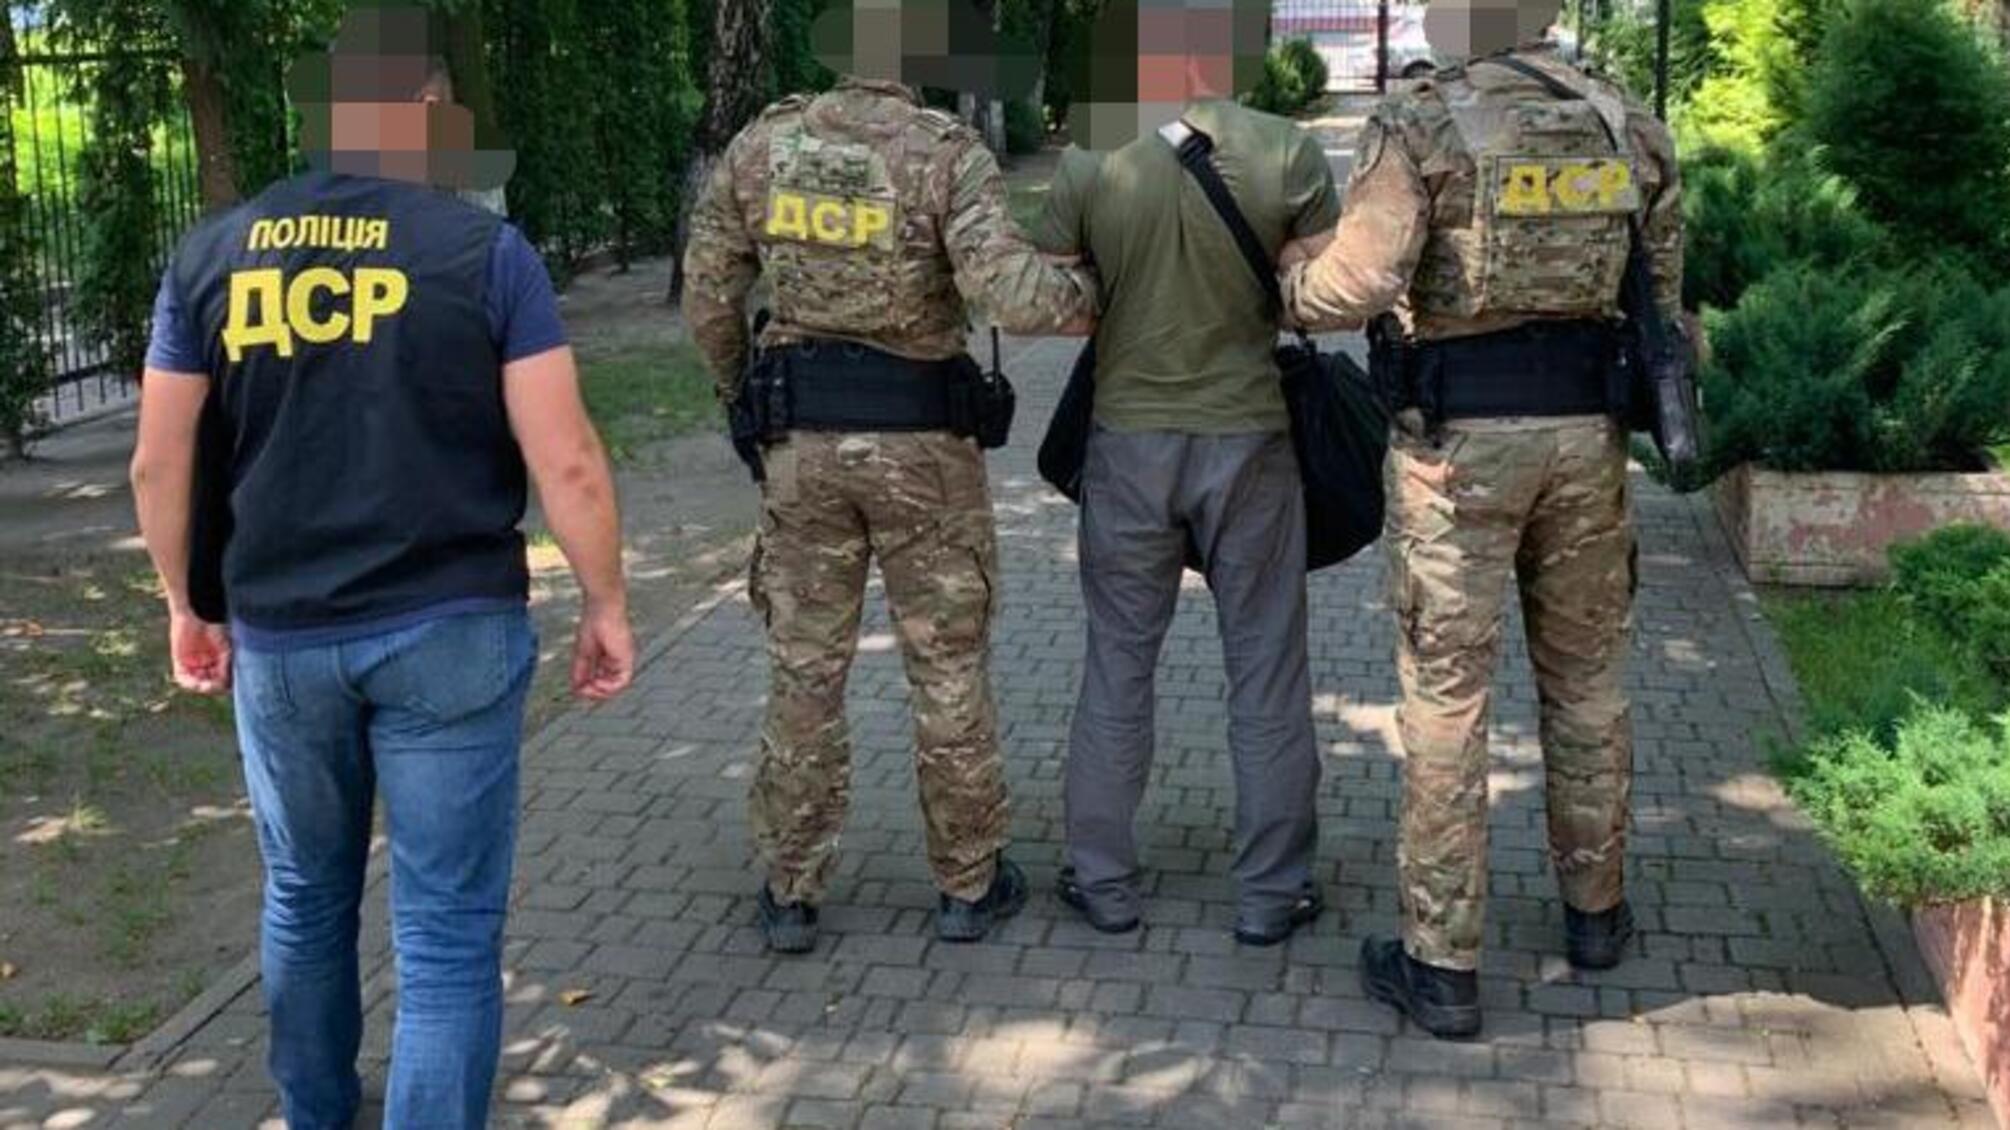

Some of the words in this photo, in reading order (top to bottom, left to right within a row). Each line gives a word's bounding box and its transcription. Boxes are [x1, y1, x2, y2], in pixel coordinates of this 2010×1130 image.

[1499, 159, 1629, 216] ДСР
[248, 215, 388, 251] ПОЛІЦІЯ
[766, 194, 888, 246] ДСР
[221, 267, 408, 362] ДСР
